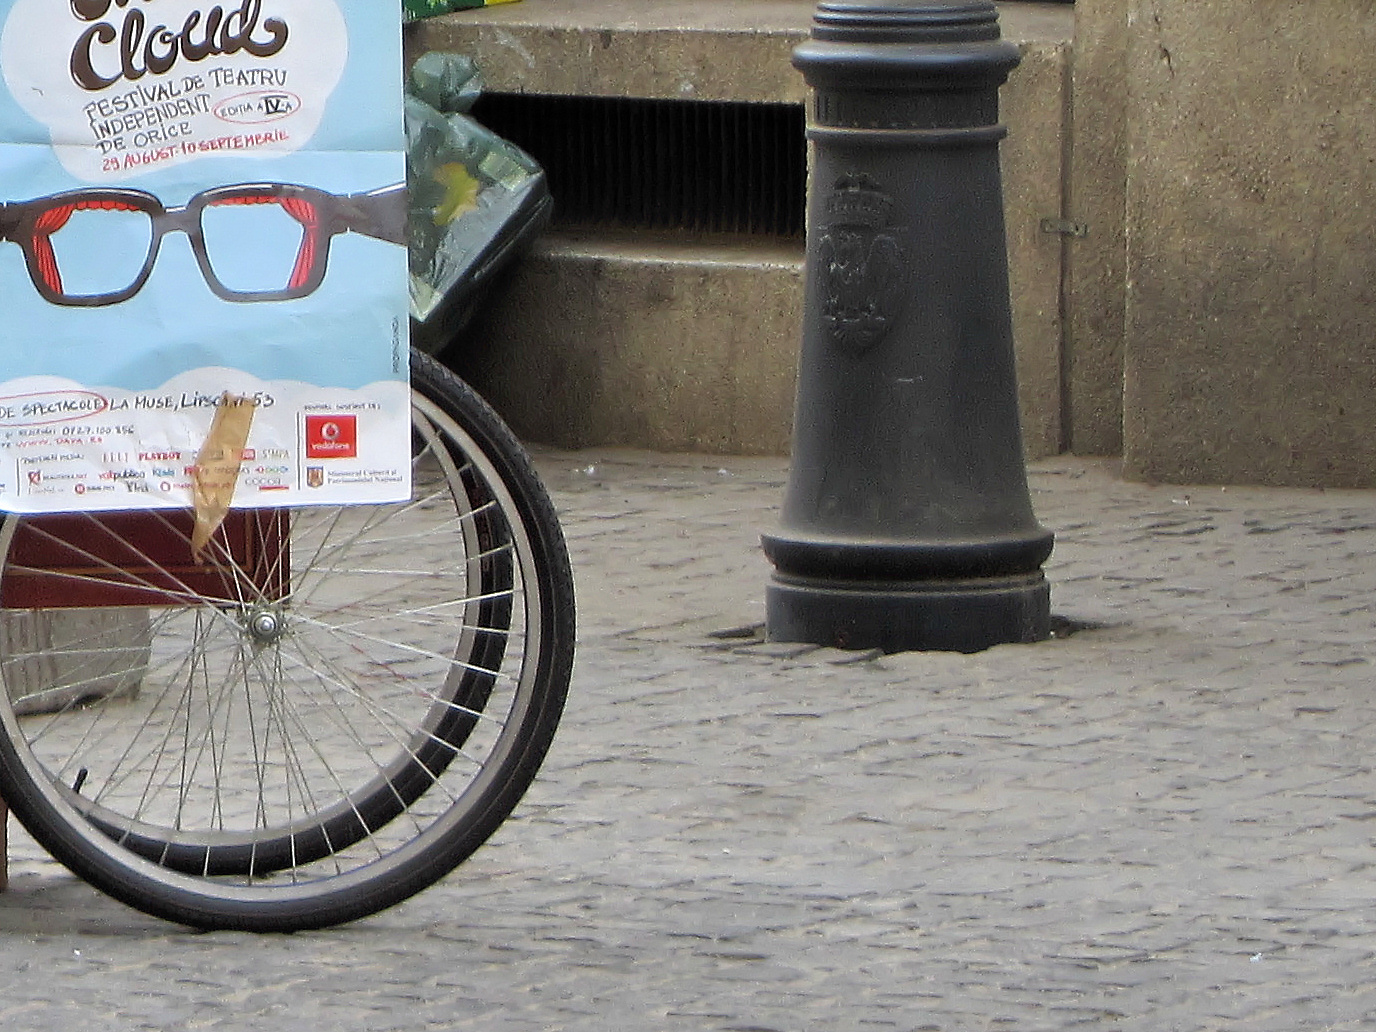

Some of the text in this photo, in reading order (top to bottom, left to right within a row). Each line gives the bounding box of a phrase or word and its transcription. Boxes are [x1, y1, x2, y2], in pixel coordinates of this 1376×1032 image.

[84, 66, 287, 124] FESTIVAL DE TEATRU
[91, 93, 211, 140] INDEPENDENT
[96, 121, 193, 155] DE ORICE
[102, 157, 119, 172] 29
[23, 399, 101, 418] SPECTACOLE
[109, 398, 129, 411] LA
[253, 391, 275, 408] 53
